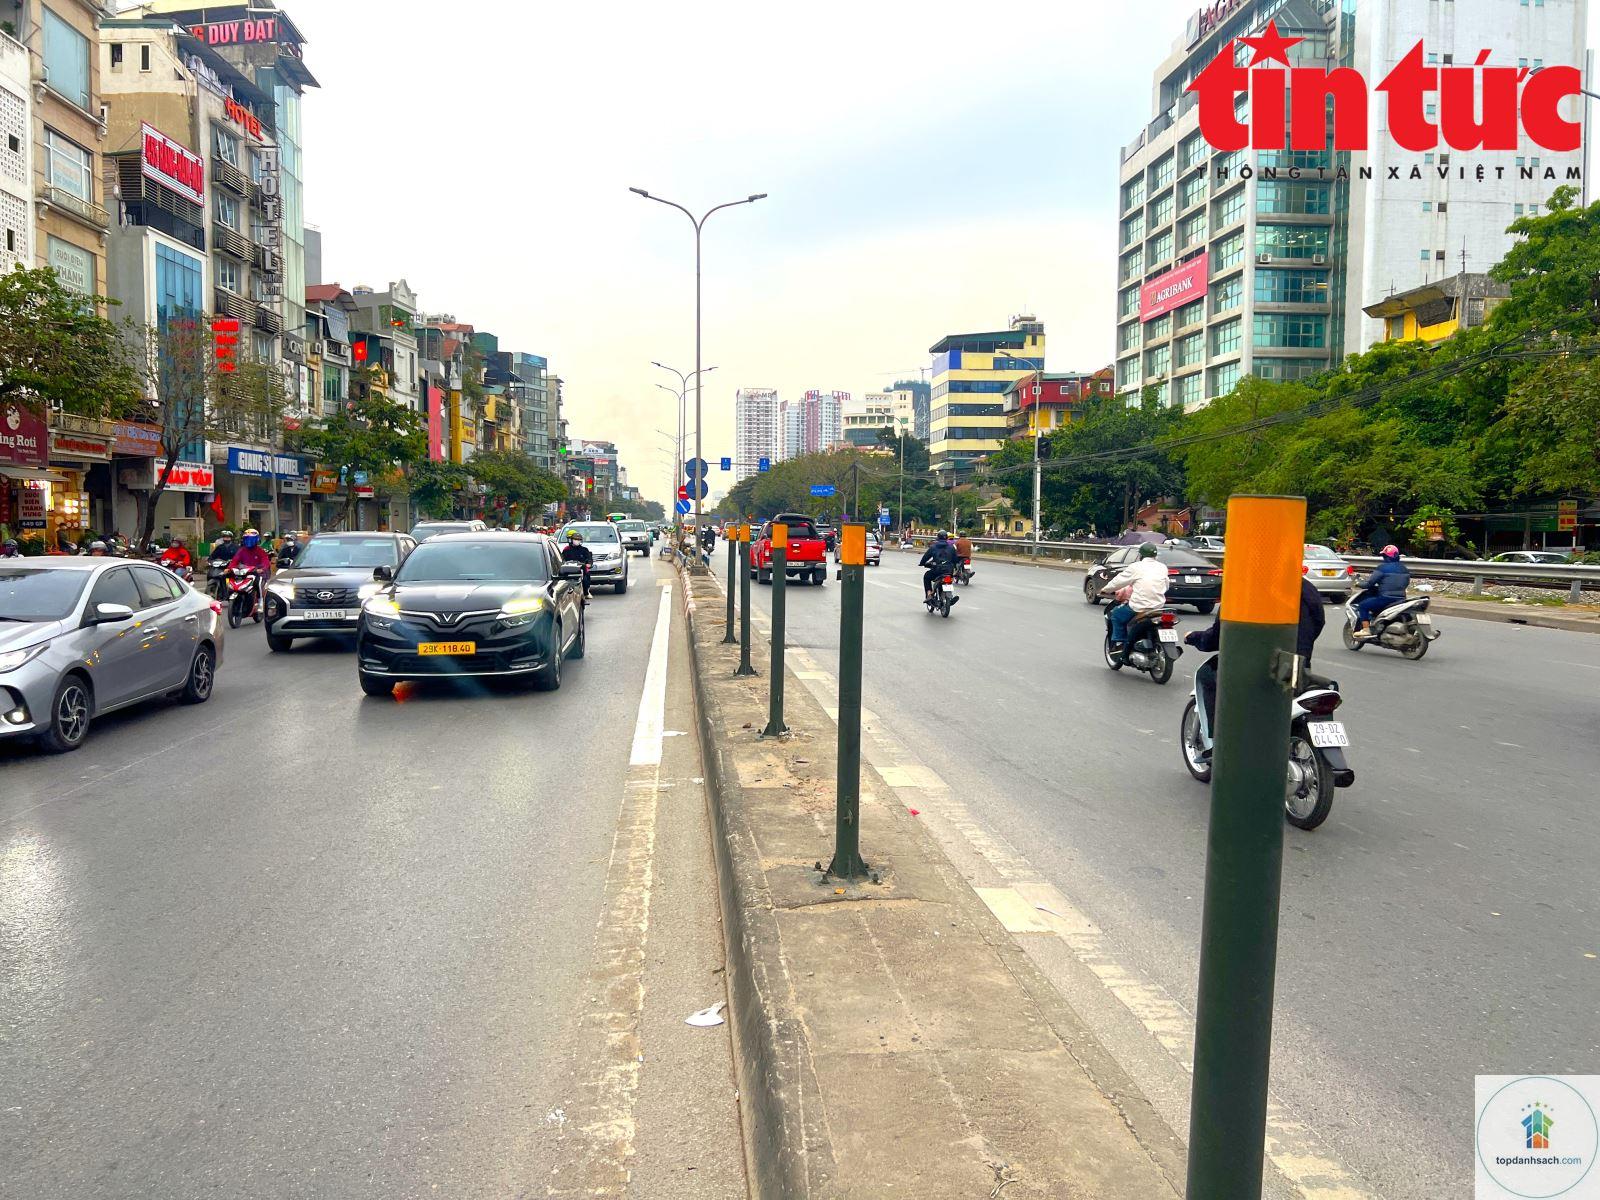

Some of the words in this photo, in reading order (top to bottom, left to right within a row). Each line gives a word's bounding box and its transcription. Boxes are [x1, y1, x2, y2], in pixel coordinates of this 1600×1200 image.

[208, 22, 240, 45] DUY
[243, 18, 275, 43] ĐẠT
[224, 95, 265, 142] HOTEL
[260, 150, 280, 271] HOTEL
[1156, 276, 1193, 303] AGRIBANK
[16, 434, 37, 448] Roti
[238, 452, 263, 472] GIANG
[423, 644, 470, 653] 29K-118.40
